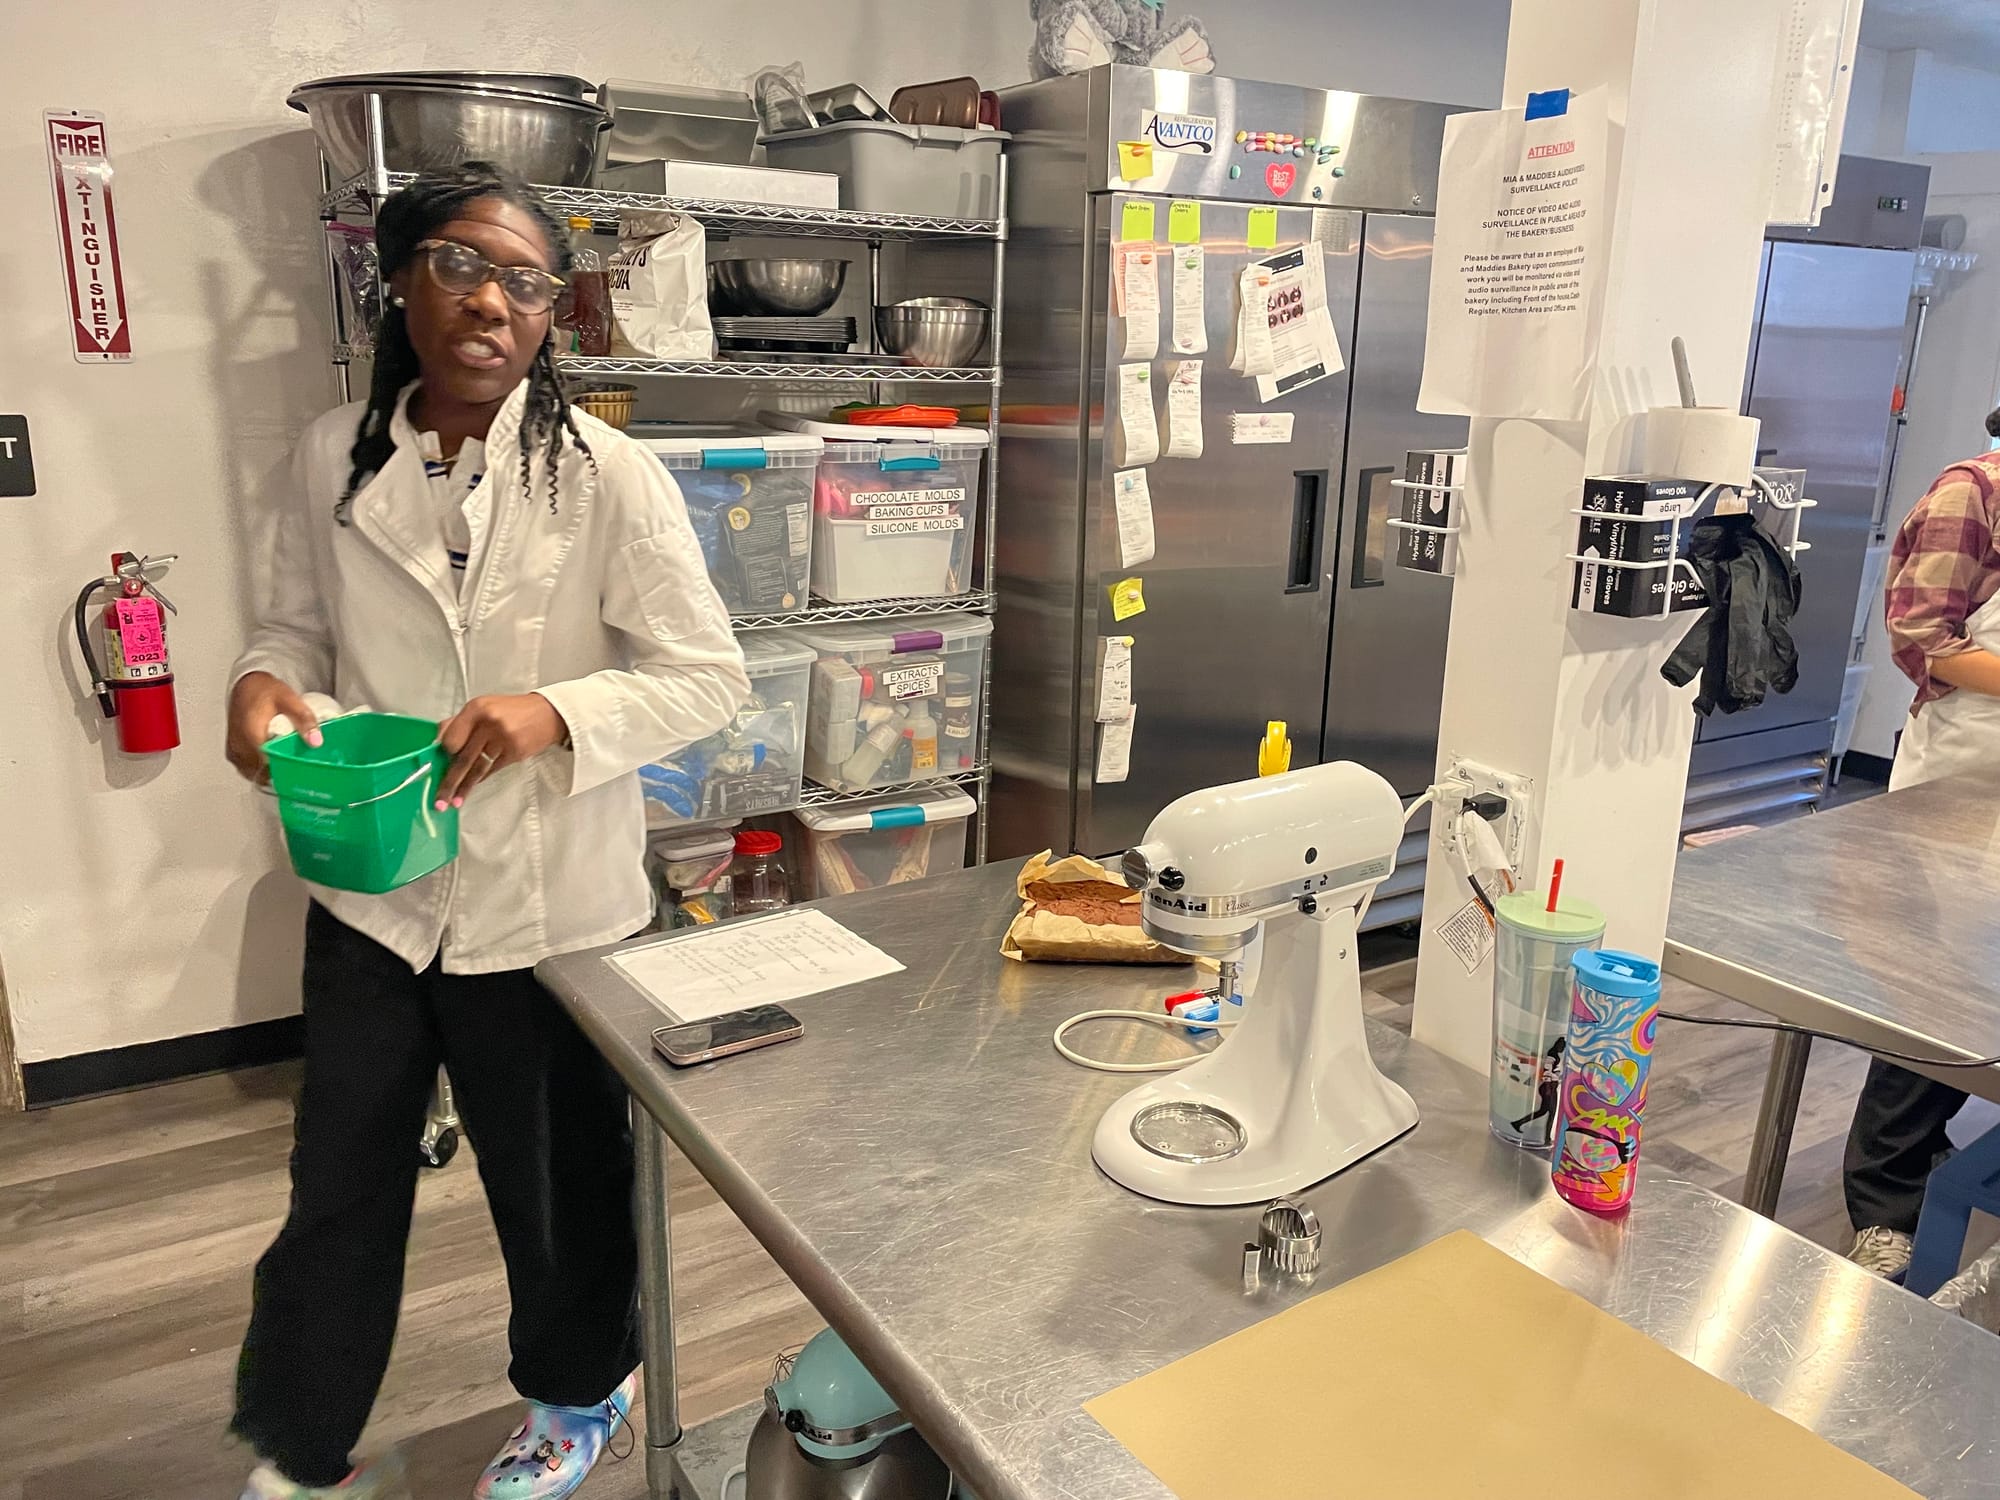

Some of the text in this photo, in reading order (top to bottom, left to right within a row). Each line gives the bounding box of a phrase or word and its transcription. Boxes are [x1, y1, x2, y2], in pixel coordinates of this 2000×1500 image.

[1174, 114, 1214, 126] REFRIGERATION
[1144, 114, 1214, 146] AVANTCO
[56, 133, 101, 156] FIRE
[1528, 140, 1575, 158] ATTENTION
[1503, 175, 1518, 184] MIA
[1526, 170, 1557, 181] MADDIES
[1510, 177, 1579, 194] SURVEILLANCE POLICY
[1497, 207, 1525, 217] NOTICE
[1526, 206, 1537, 215] OF
[1538, 203, 1557, 213] VIDEO
[1558, 202, 1569, 211] AND
[1482, 217, 1539, 229] SURVEILLANCE
[1540, 217, 1547, 225] IN
[1548, 213, 1567, 224] PUBLIC
[1506, 224, 1575, 239] THE BAKERY BUSINESS
[1464, 254, 1489, 262] Please
[1490, 253, 1500, 261] be
[1523, 251, 1536, 259] that
[1460, 264, 1474, 272] and
[1476, 264, 1506, 272] Maddies
[1508, 263, 1530, 272] Bakery
[1532, 262, 1547, 271] upon
[607, 268, 630, 290] OCOA
[1467, 275, 1485, 283] work
[1487, 276, 1500, 284] you
[1502, 274, 1514, 282] will
[1525, 272, 1555, 280] monitored
[1468, 286, 1489, 295] audio
[1491, 285, 1531, 295] surveillance
[1532, 284, 1538, 292] in
[1539, 282, 1556, 292] public
[1464, 297, 1489, 305] bakery
[1491, 295, 1522, 304] including
[1523, 295, 1539, 303] Front
[1540, 294, 1548, 302] of
[1468, 306, 1501, 317] Register,
[1502, 305, 1527, 315] Kitchen
[1528, 306, 1542, 315] Area
[1543, 306, 1553, 314] and
[1433, 469, 1443, 499] Lrge
[1655, 486, 1687, 496] 100 Gloves
[855, 489, 961, 504] CHOCOLATE MOLDS
[1614, 490, 1625, 513] Hybr
[875, 504, 944, 518] BAKING CUPS
[1414, 489, 1425, 535] Vyl/Nitrile
[1660, 503, 1681, 513] Large
[871, 518, 959, 534] SILICONE MOLDS
[1412, 535, 1420, 561] Hybrid
[1607, 522, 1620, 575] Vinyl/Nitle
[1584, 562, 1595, 595] Large
[1603, 575, 1614, 606] Gloves
[131, 652, 160, 663] 2023
[890, 665, 940, 682] EXTRACTS
[896, 679, 930, 694] SPICES
[1150, 893, 1207, 912] enAid
